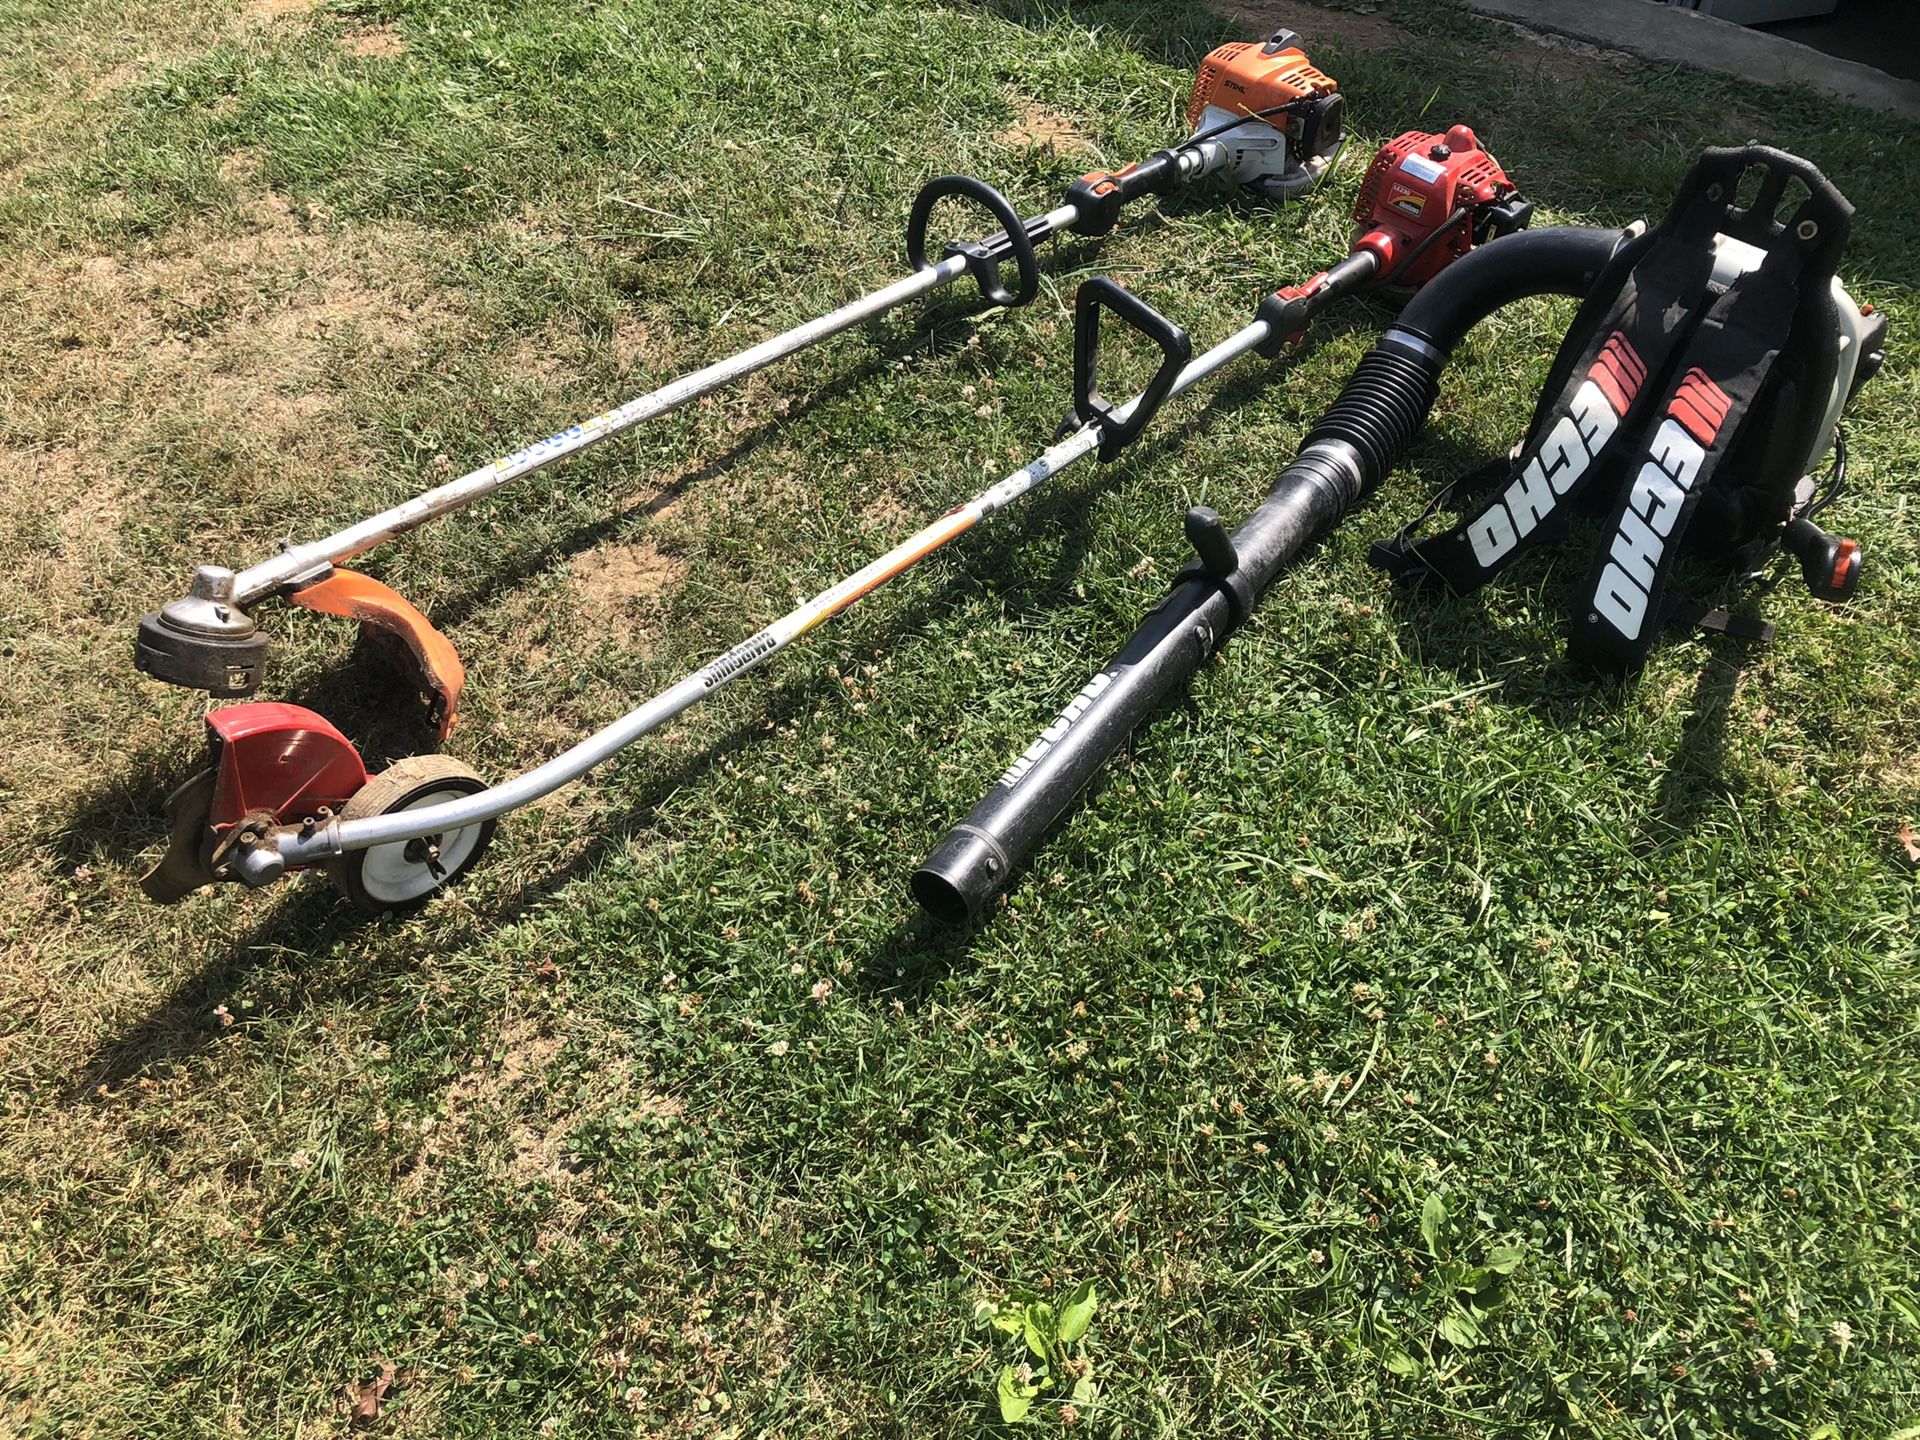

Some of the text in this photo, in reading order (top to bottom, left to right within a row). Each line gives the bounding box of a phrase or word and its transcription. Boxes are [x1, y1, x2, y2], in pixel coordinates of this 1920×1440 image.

[1223, 79, 1247, 95] STIHL
[1466, 380, 1619, 568] ECHO
[1593, 418, 1706, 640] ECHO
